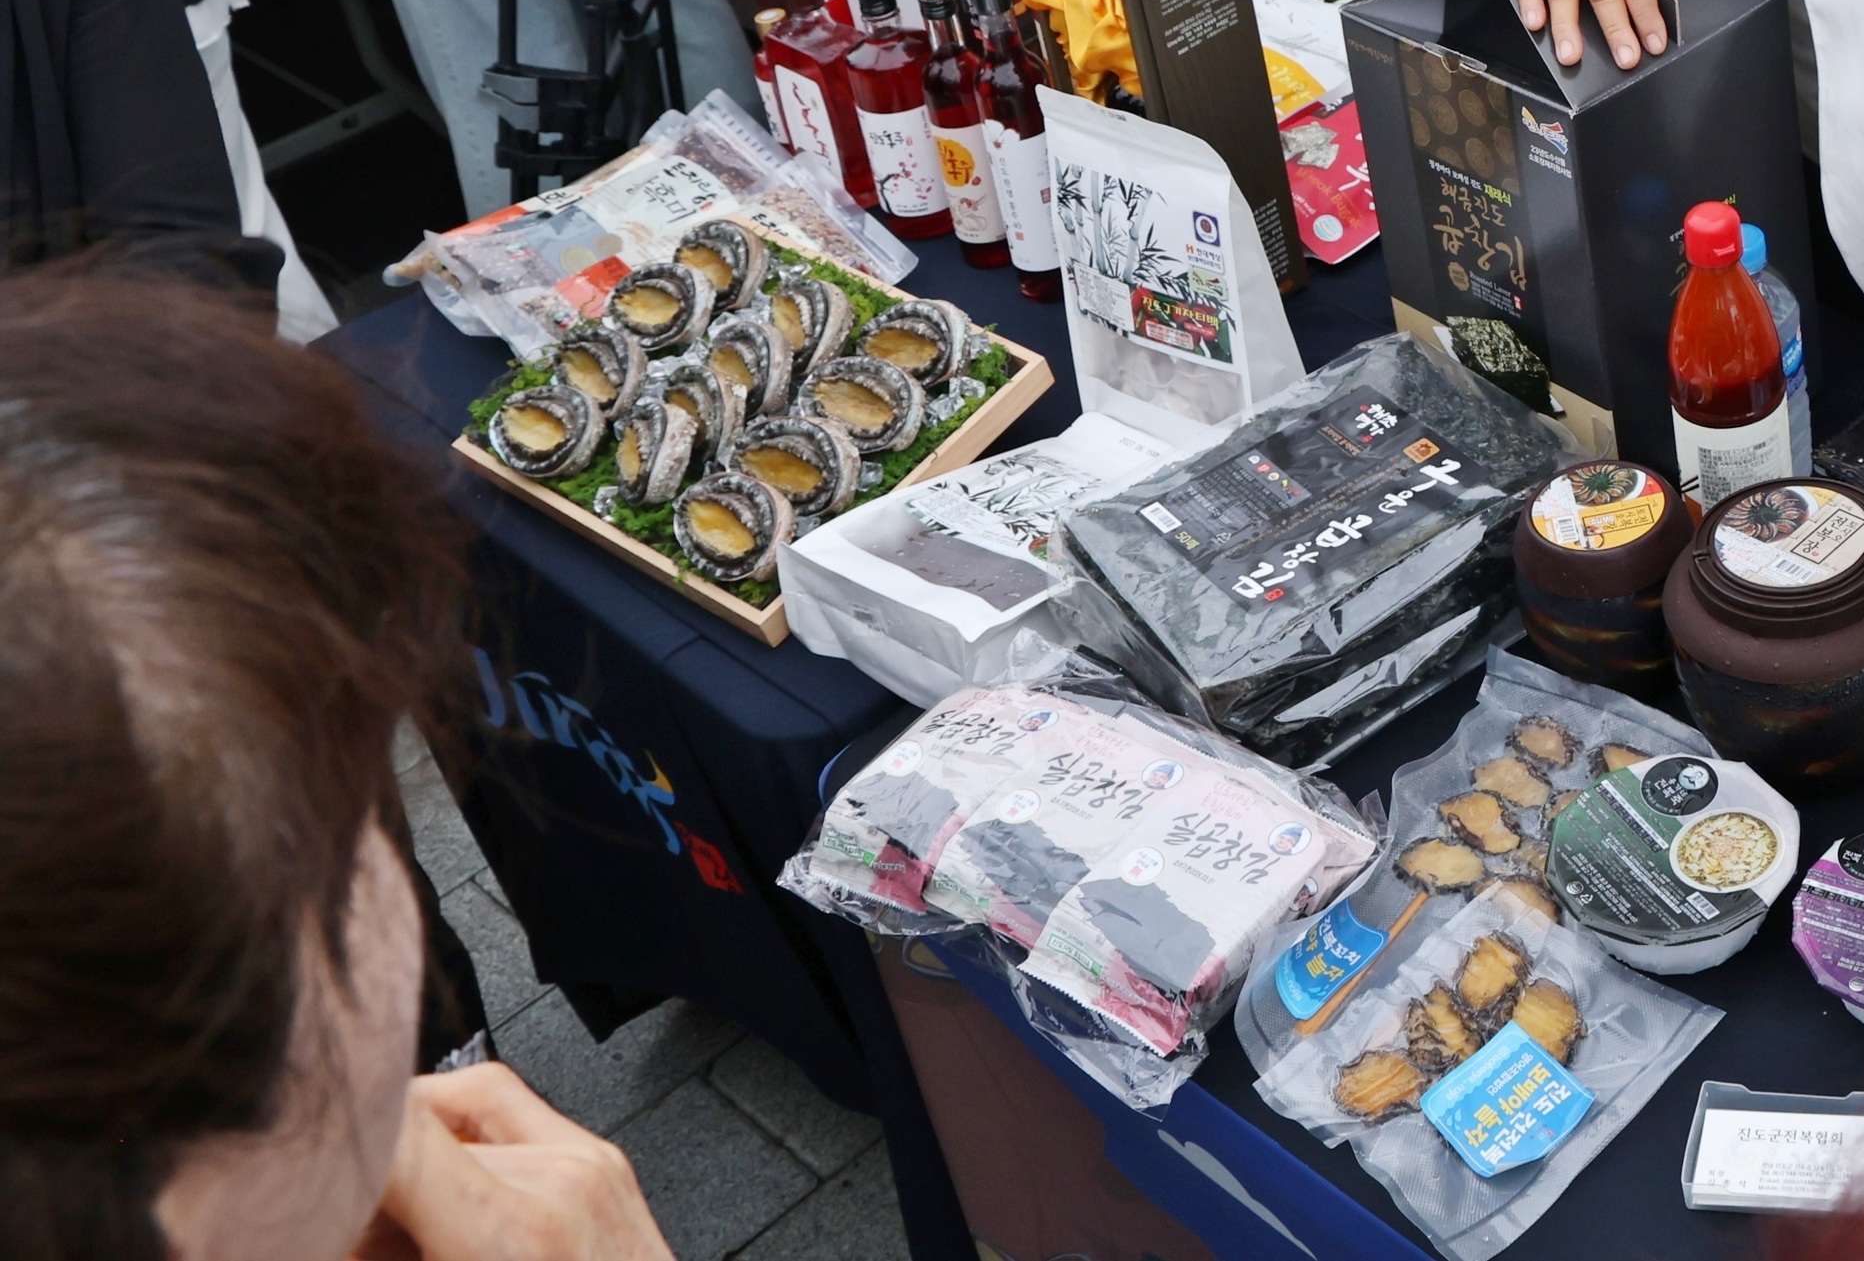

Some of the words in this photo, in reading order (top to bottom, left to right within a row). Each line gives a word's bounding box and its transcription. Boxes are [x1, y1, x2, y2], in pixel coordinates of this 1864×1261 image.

[1331, 192, 1363, 230] Bugak
[1483, 183, 1513, 208] 재래식
[1433, 205, 1528, 292] 곱창김
[1355, 413, 1385, 437] 명가
[1367, 403, 1398, 429] 해초
[1802, 515, 1850, 554] 전복장
[1232, 514, 1374, 599] 곱창김
[920, 708, 1028, 757] 실곱창김
[1039, 753, 1155, 819] 실곱창김
[1654, 778, 1687, 807] 전복죽
[1163, 812, 1282, 886] 실곱창김
[1841, 850, 1861, 864] 전복
[1319, 915, 1362, 966] 전복꼬치
[1305, 953, 1345, 983] 놀자
[1486, 1052, 1535, 1096] 영어조합법인
[1498, 1062, 1552, 1116] 보배야
[1533, 1080, 1572, 1116] 진도
[1463, 1103, 1503, 1148] 놀자
[1479, 1111, 1537, 1165] 건전복
[1737, 1127, 1844, 1146] 진도군전복협회
